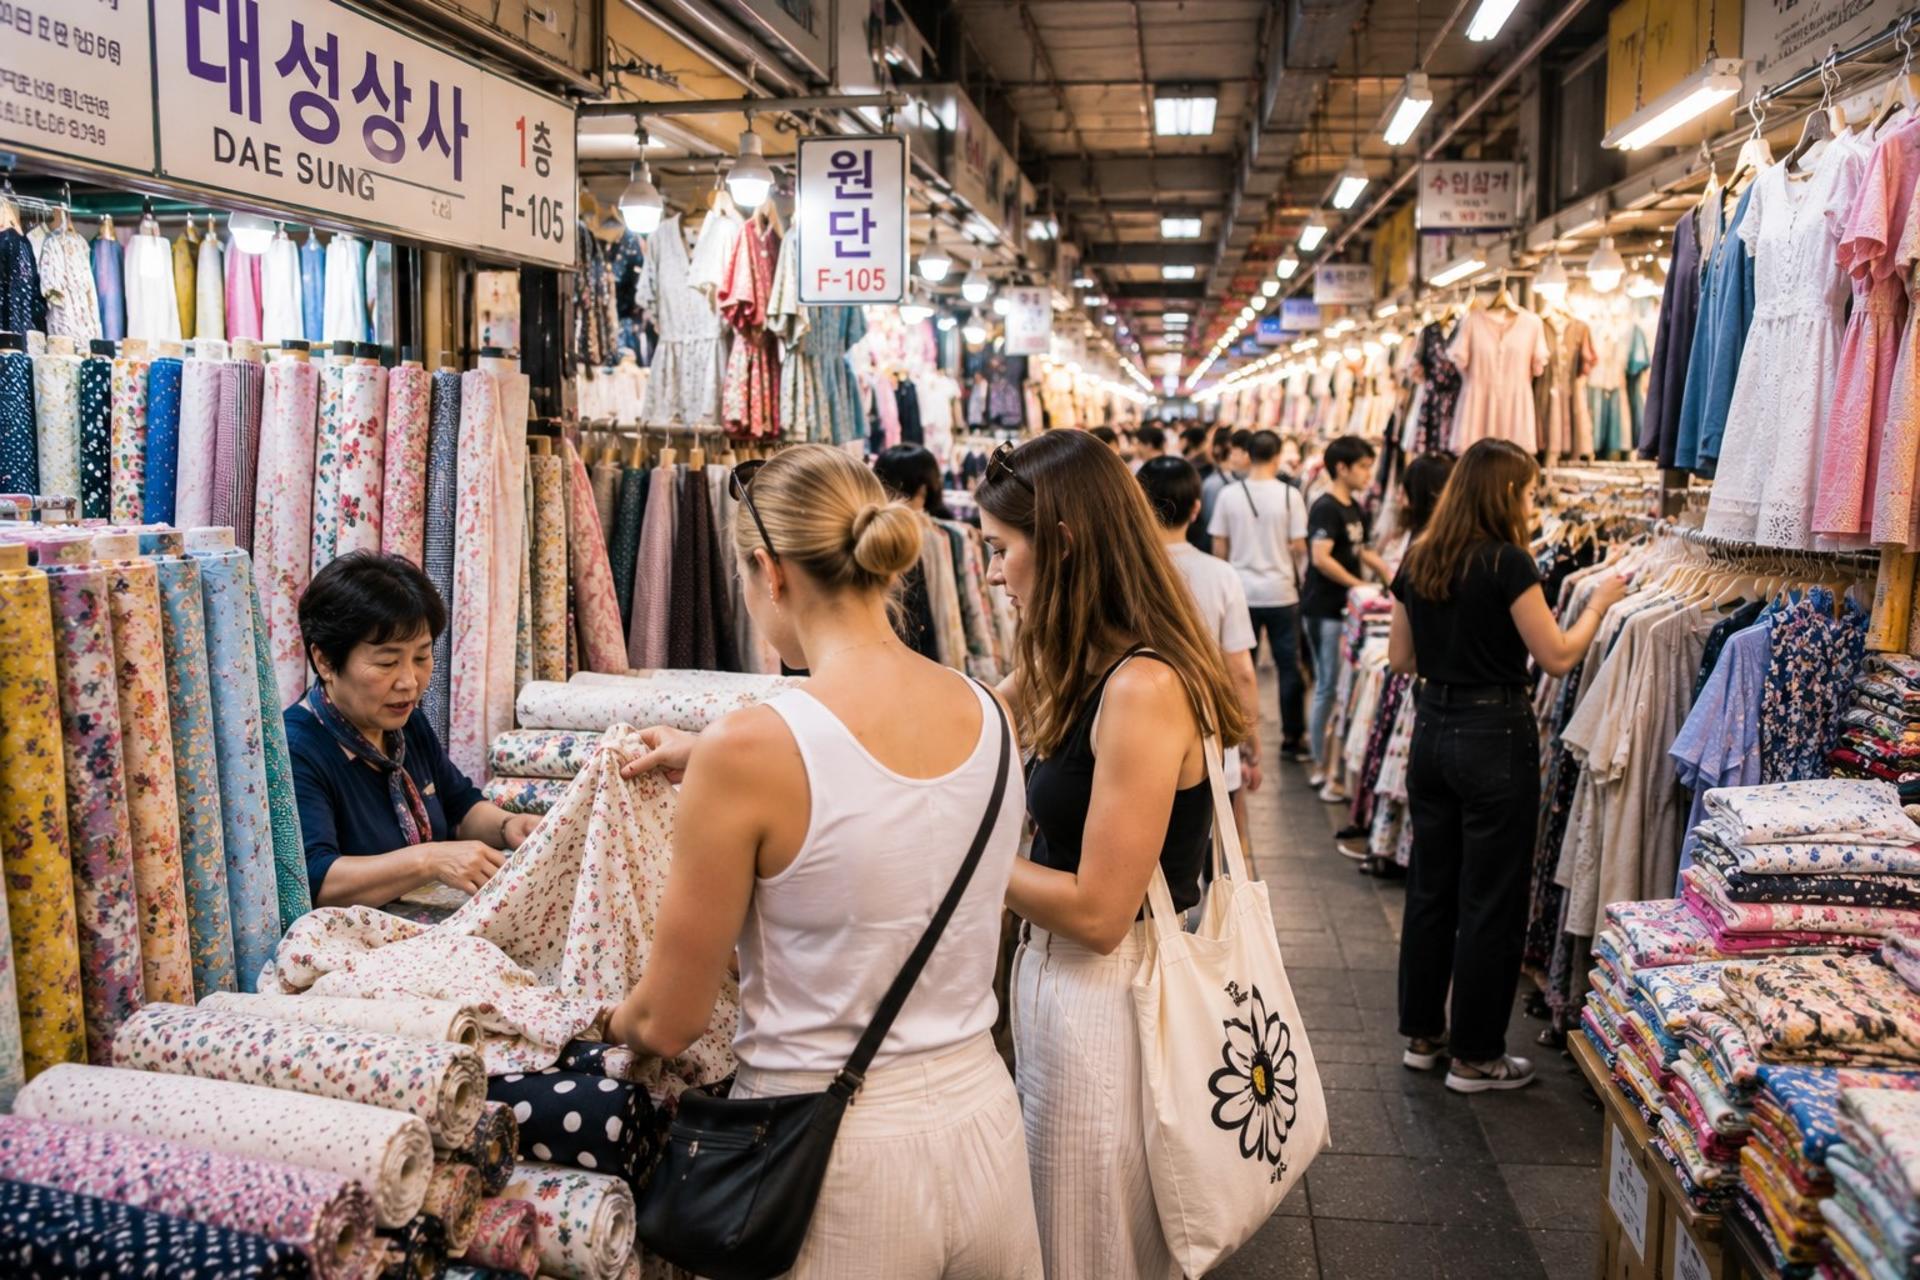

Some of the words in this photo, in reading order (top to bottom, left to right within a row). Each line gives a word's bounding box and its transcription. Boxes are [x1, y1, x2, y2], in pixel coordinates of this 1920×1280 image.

[185, 0, 469, 182] 대성상사
[213, 126, 284, 178] DAE
[296, 151, 375, 201] SUNG
[516, 115, 552, 178] 1층
[501, 184, 564, 243] F-105
[827, 149, 877, 258] 원단
[817, 268, 886, 292] F-105
